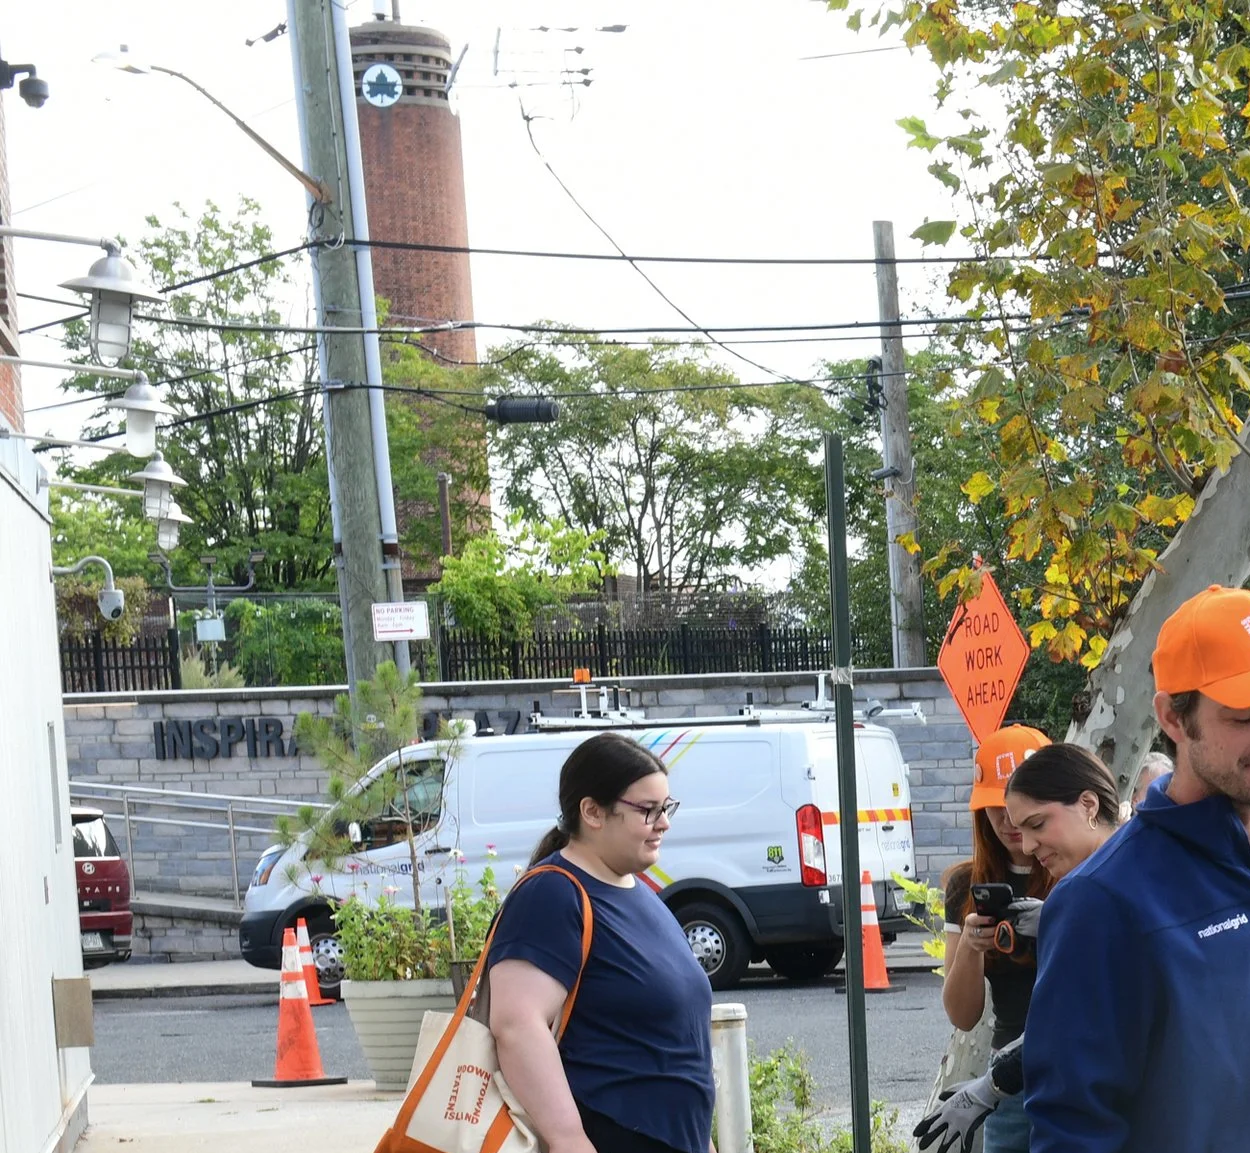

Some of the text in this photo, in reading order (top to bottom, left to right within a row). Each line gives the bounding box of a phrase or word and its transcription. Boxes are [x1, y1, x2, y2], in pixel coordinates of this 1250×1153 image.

[964, 612, 999, 638] ROAD
[965, 645, 1003, 672] WORK
[966, 680, 1006, 708] AHEAD
[768, 846, 783, 859] 811
[355, 860, 425, 876] nationalgrd
[828, 873, 843, 882] 367
[107, 885, 121, 893] FE
[1197, 913, 1249, 939] nationalgrid
